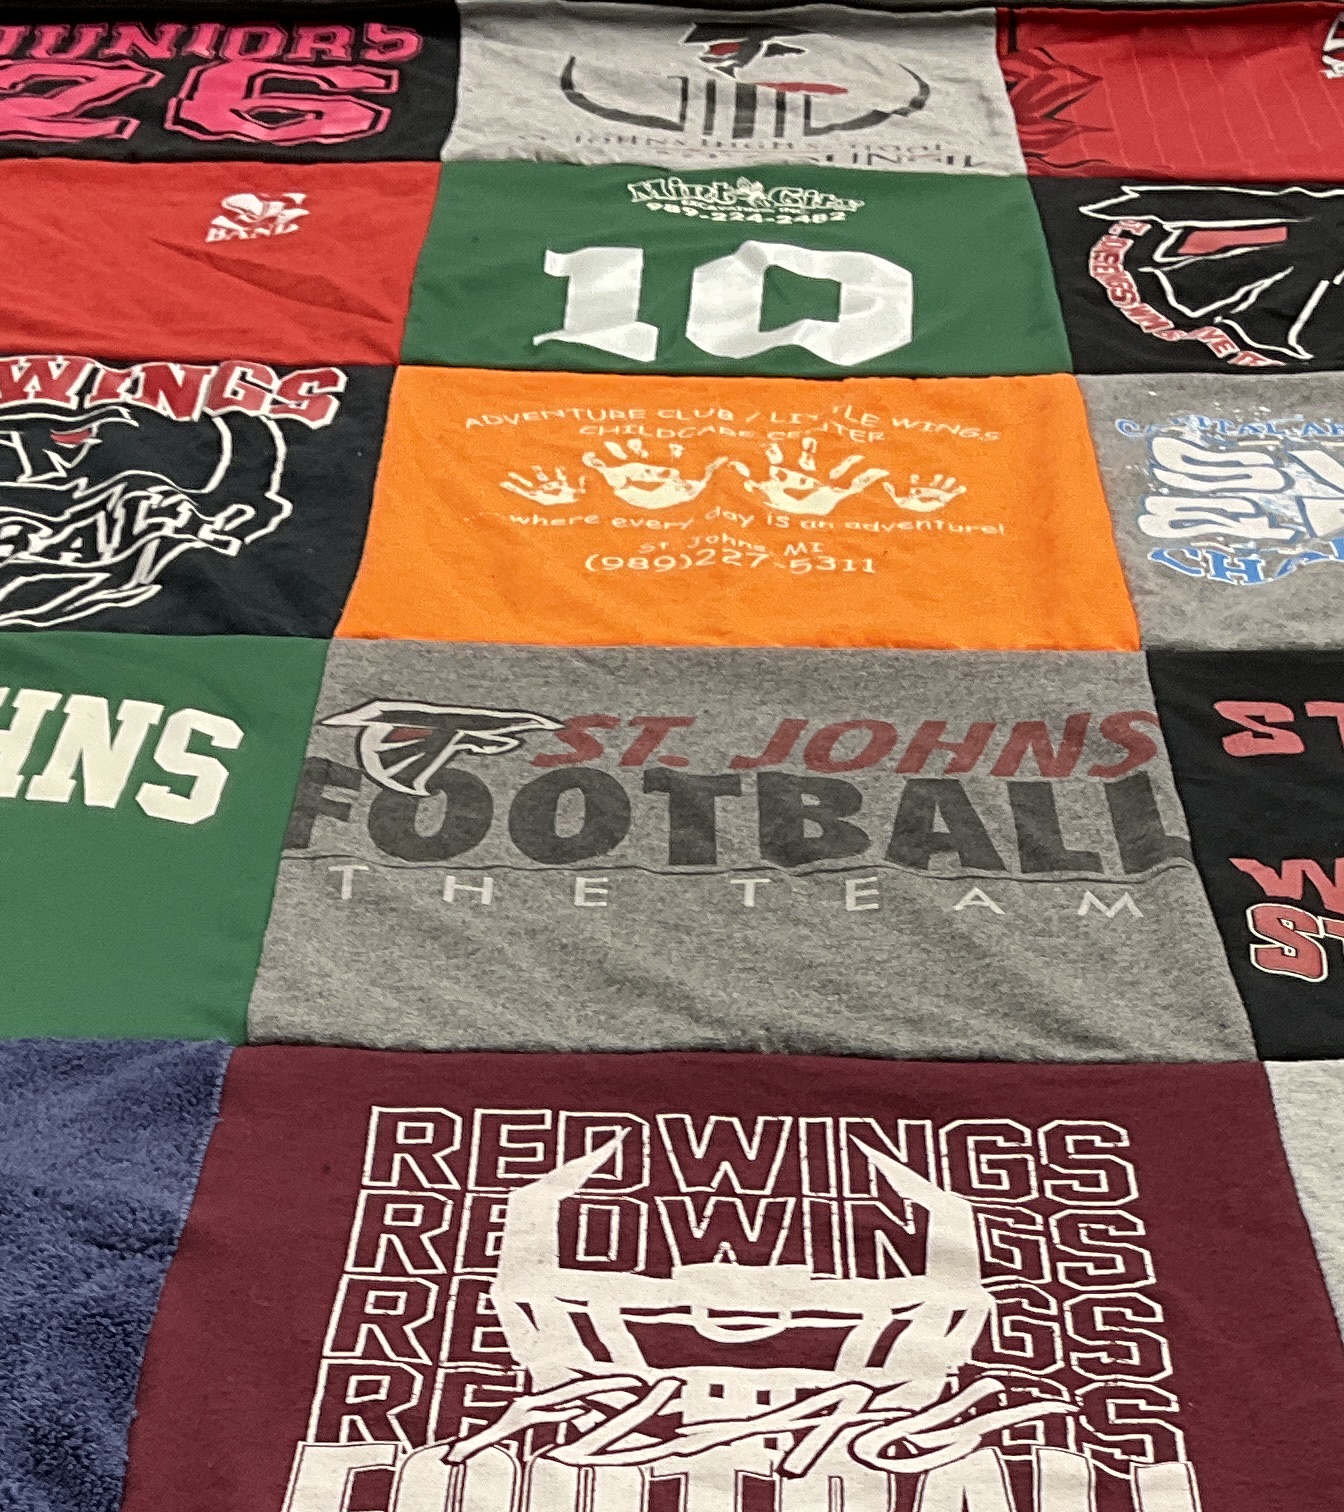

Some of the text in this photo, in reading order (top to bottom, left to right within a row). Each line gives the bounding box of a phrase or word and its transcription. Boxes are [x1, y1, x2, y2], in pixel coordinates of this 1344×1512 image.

[533, 240, 914, 366] 10
[466, 407, 646, 429] ADVENTURE
[657, 408, 734, 423] CLUB
[891, 416, 1002, 442] WINGS
[579, 425, 755, 439] CHILDCARE
[1115, 416, 1306, 438] CAPITAL
[509, 511, 600, 527] where
[612, 515, 695, 532] every
[705, 505, 755, 530] day
[800, 518, 835, 530] an
[783, 541, 824, 558] MI
[529, 710, 1159, 779] ST. JOHNS
[280, 755, 1194, 877] FOOTBALL
[328, 865, 1144, 920] THE TEAM
[361, 1104, 1144, 1209] REDWINGS
[324, 1273, 1173, 1380] REGS
[446, 1368, 1088, 1478] FLAG
